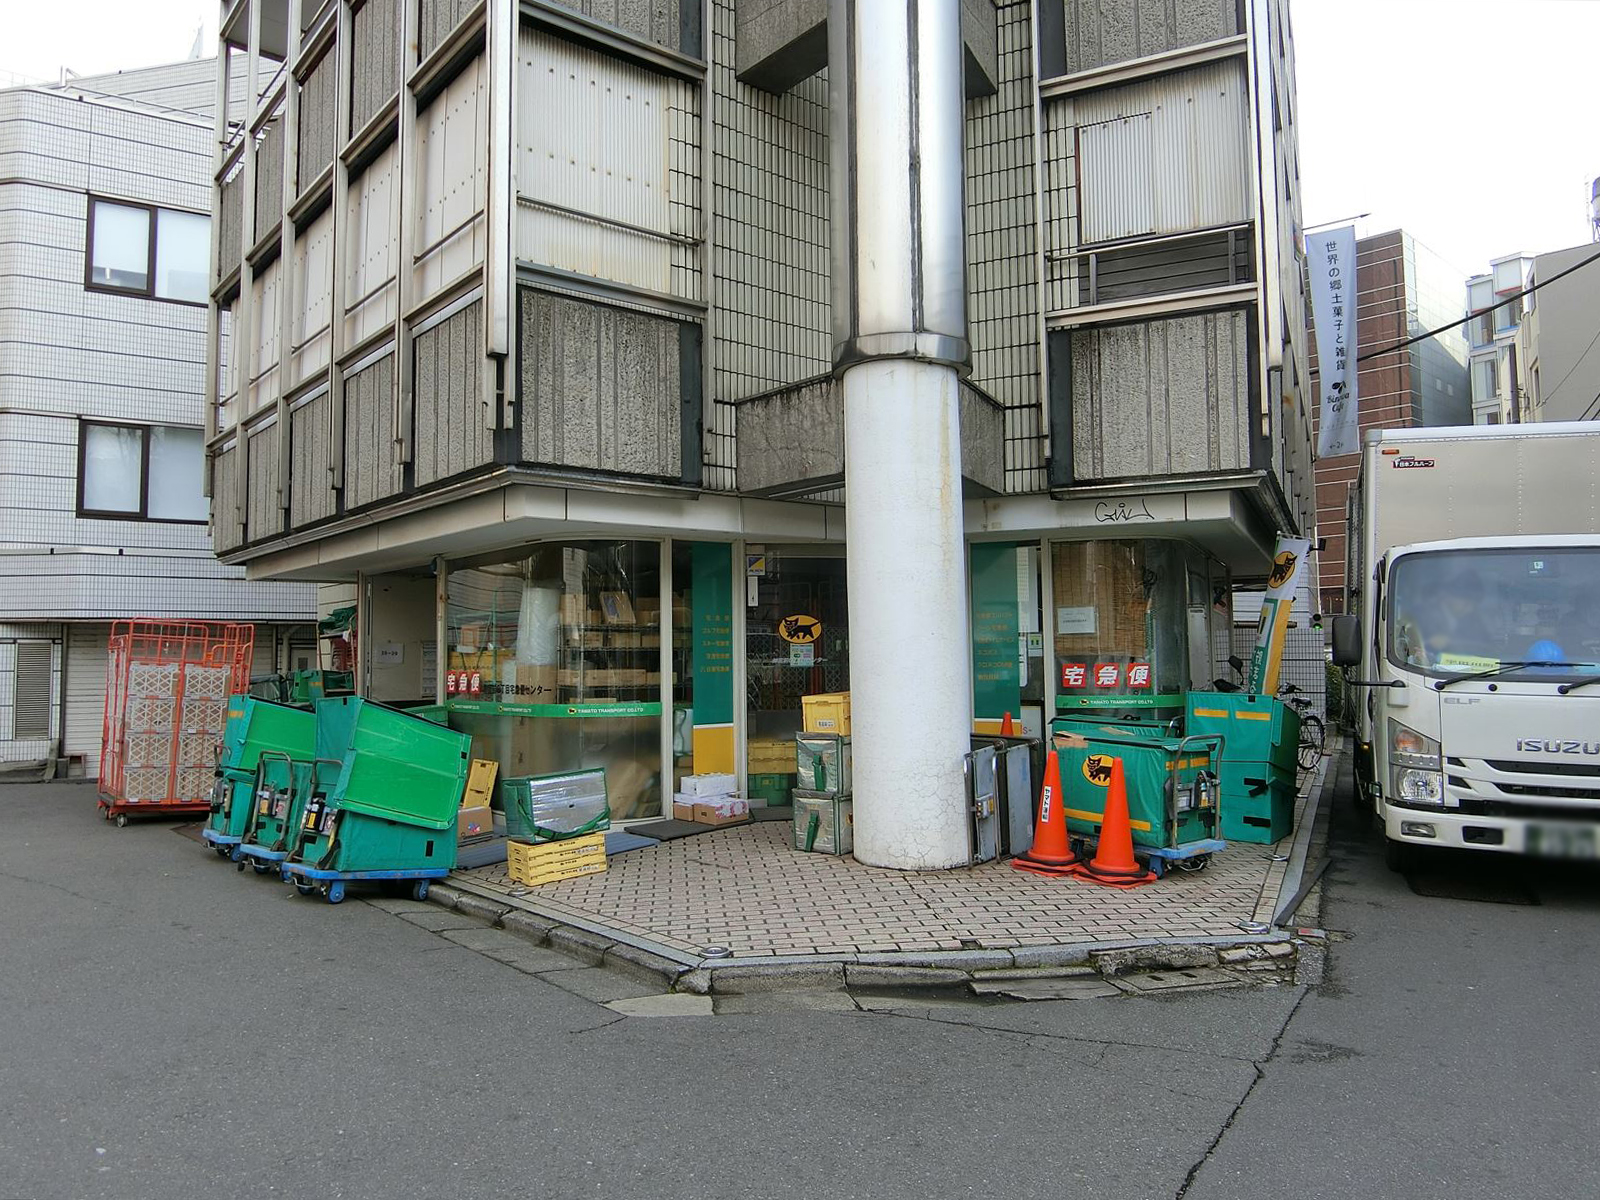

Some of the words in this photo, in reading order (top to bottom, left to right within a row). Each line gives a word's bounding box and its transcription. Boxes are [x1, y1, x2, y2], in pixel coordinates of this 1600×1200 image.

[1325, 241, 1346, 372] 世界の郷土菓子と雑貨
[447, 672, 480, 692] 宅急便
[1064, 665, 1150, 686] 宅急便
[1443, 697, 1481, 705] ELF
[1516, 737, 1600, 755] ISUZU
